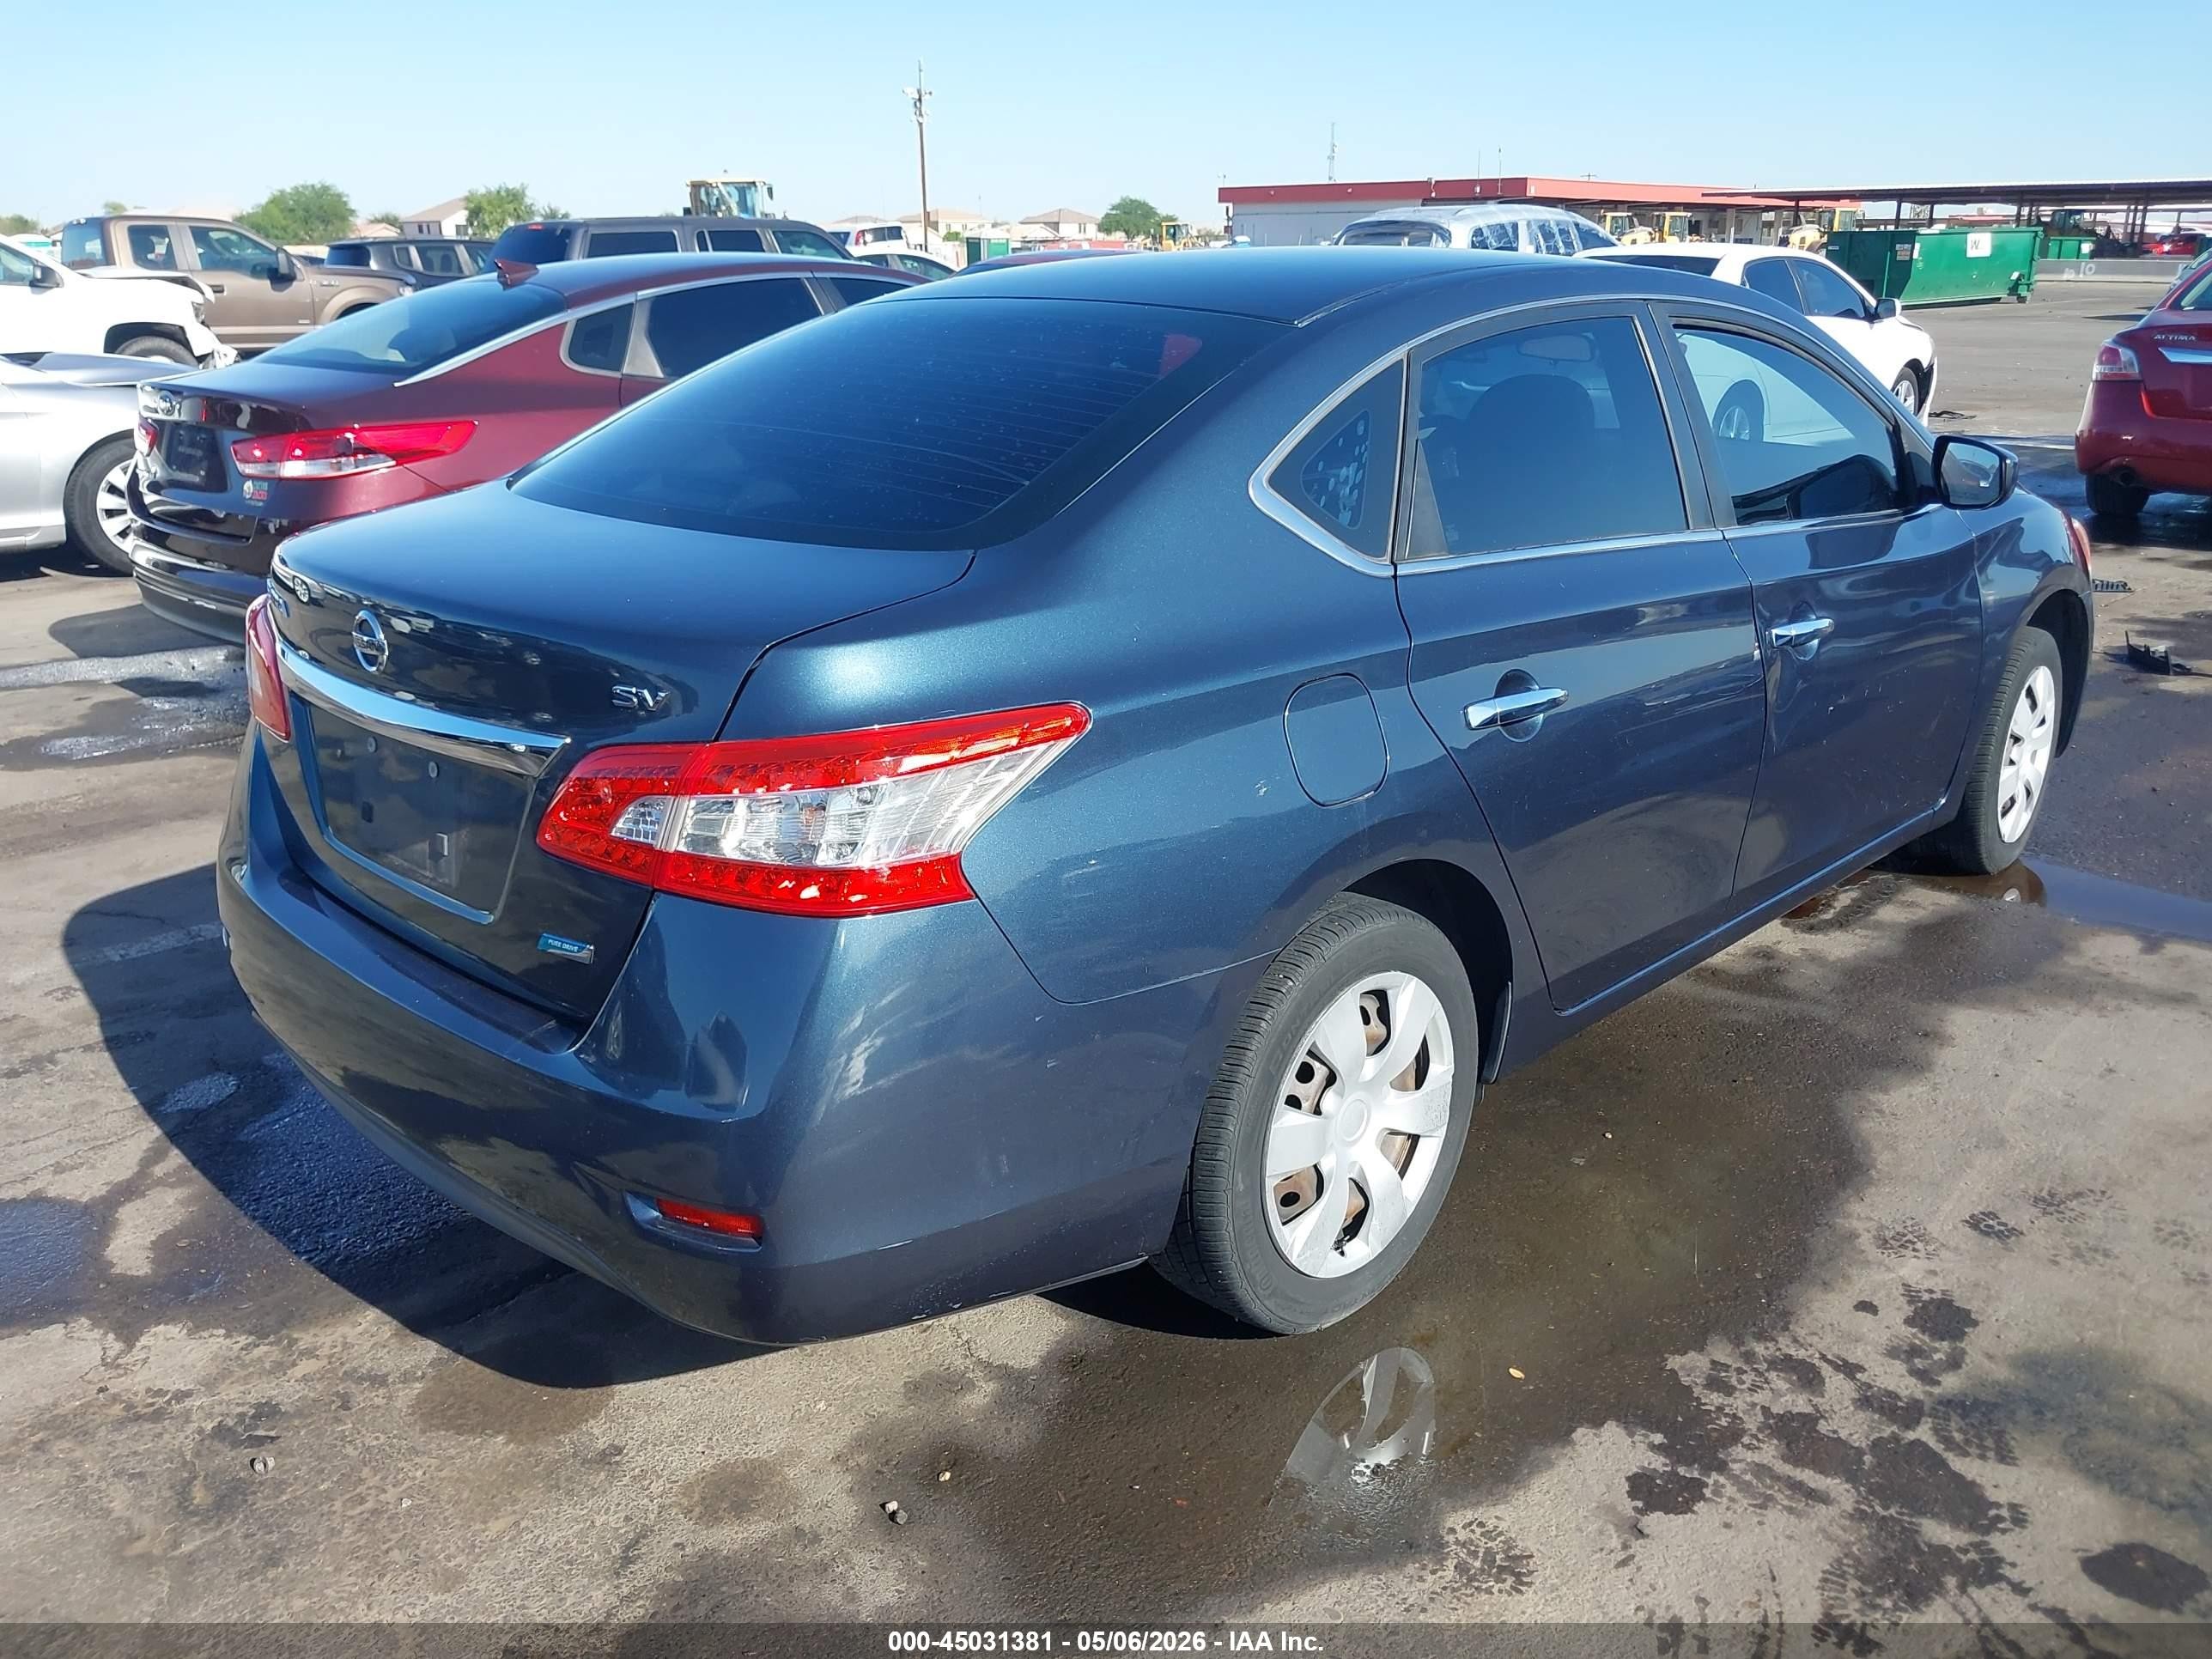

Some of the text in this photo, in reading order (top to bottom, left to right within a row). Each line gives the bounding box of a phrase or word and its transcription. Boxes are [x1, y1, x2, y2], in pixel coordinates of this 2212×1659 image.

[612, 686, 670, 711] SV
[548, 939, 579, 952] PURE DRIVE
